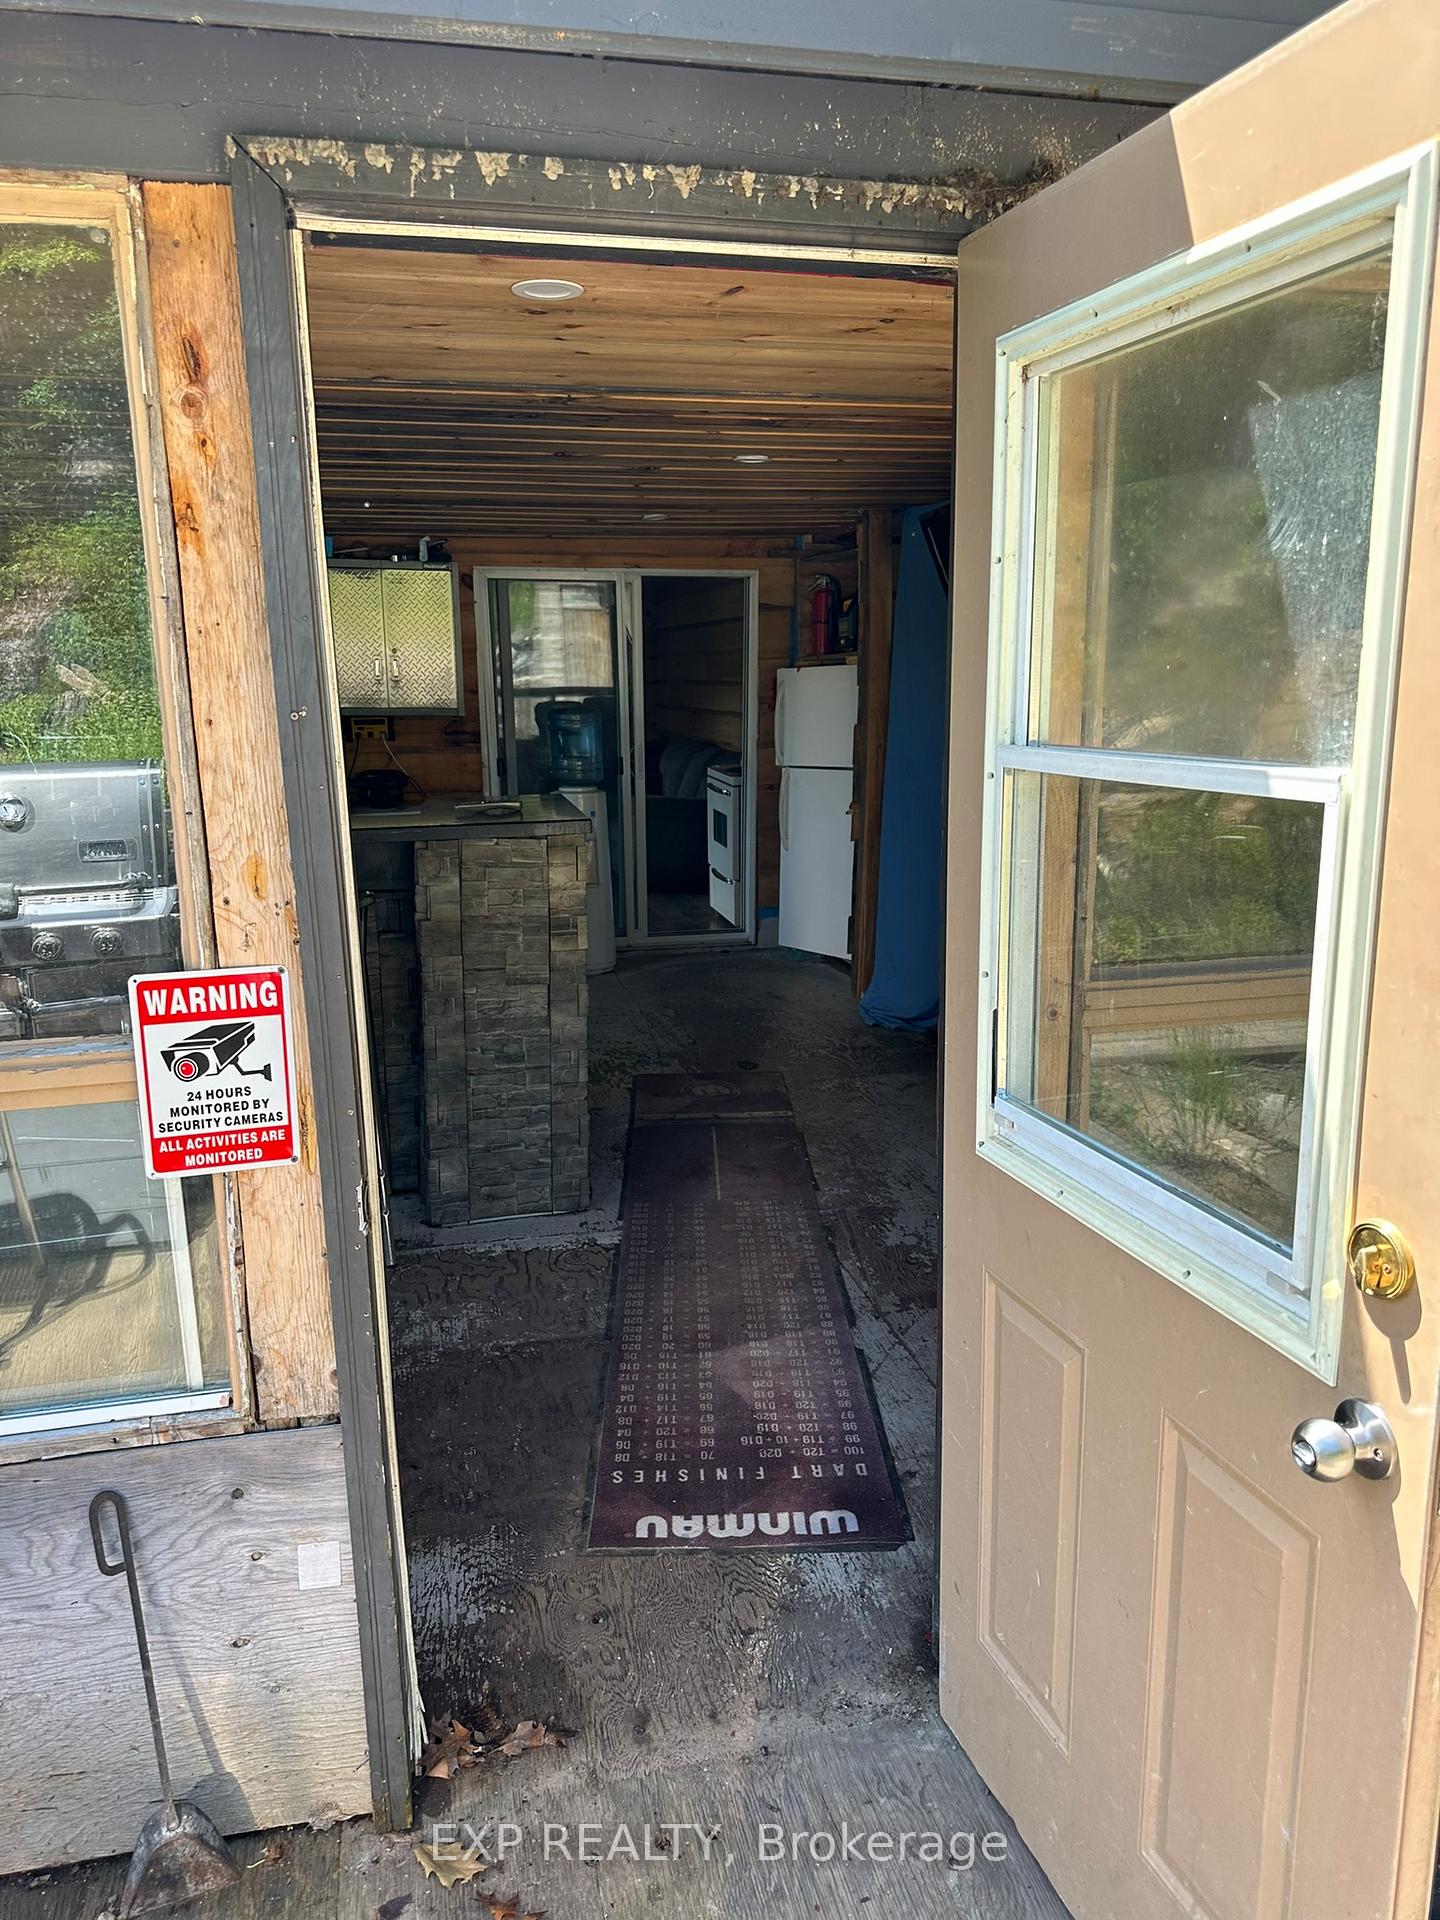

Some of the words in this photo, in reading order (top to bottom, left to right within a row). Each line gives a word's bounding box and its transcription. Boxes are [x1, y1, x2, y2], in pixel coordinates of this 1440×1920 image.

[143, 981, 278, 1016] WARNING
[187, 1091, 201, 1101] 24
[206, 1086, 251, 1100] HOURS
[170, 1101, 249, 1118] MONITORED
[253, 1098, 270, 1109] BY
[158, 1117, 221, 1133] SECURITY
[224, 1112, 283, 1127] CAMERAS
[159, 1140, 183, 1153] ALL
[186, 1132, 258, 1150] ACTIVITIES
[260, 1129, 286, 1141] ARE
[185, 1148, 263, 1167] MONITORED
[618, 1373, 639, 1381] D12
[657, 1393, 677, 1401] T19
[699, 1392, 713, 1400] 65
[794, 1390, 814, 1398] T19
[836, 1389, 850, 1397] 95
[620, 1394, 634, 1402] D4
[616, 1405, 636, 1413] D12
[796, 1401, 816, 1409] T20
[656, 1415, 677, 1424] T17
[700, 1414, 714, 1422] 67
[797, 1412, 818, 1420] T19
[841, 1411, 855, 1419] 97
[618, 1417, 632, 1425] D8
[700, 1425, 714, 1434] 68
[757, 1423, 779, 1432] D19
[799, 1423, 818, 1432] T20
[842, 1422, 857, 1431] 98
[618, 1428, 631, 1437] D4
[656, 1427, 677, 1436] T20
[700, 1438, 714, 1447] 69
[740, 1436, 763, 1445] D16
[776, 1435, 789, 1444] 10
[802, 1435, 824, 1444] T19
[845, 1434, 860, 1443] 99
[616, 1441, 630, 1449] D6
[656, 1439, 677, 1449] T19
[760, 1448, 782, 1457] D20
[803, 1447, 824, 1456] T20
[844, 1446, 864, 1455] 100
[615, 1453, 630, 1462] D8
[655, 1452, 676, 1461] T18
[701, 1451, 714, 1460] 70
[612, 1464, 765, 1483] FINISHES
[791, 1463, 868, 1479] DART
